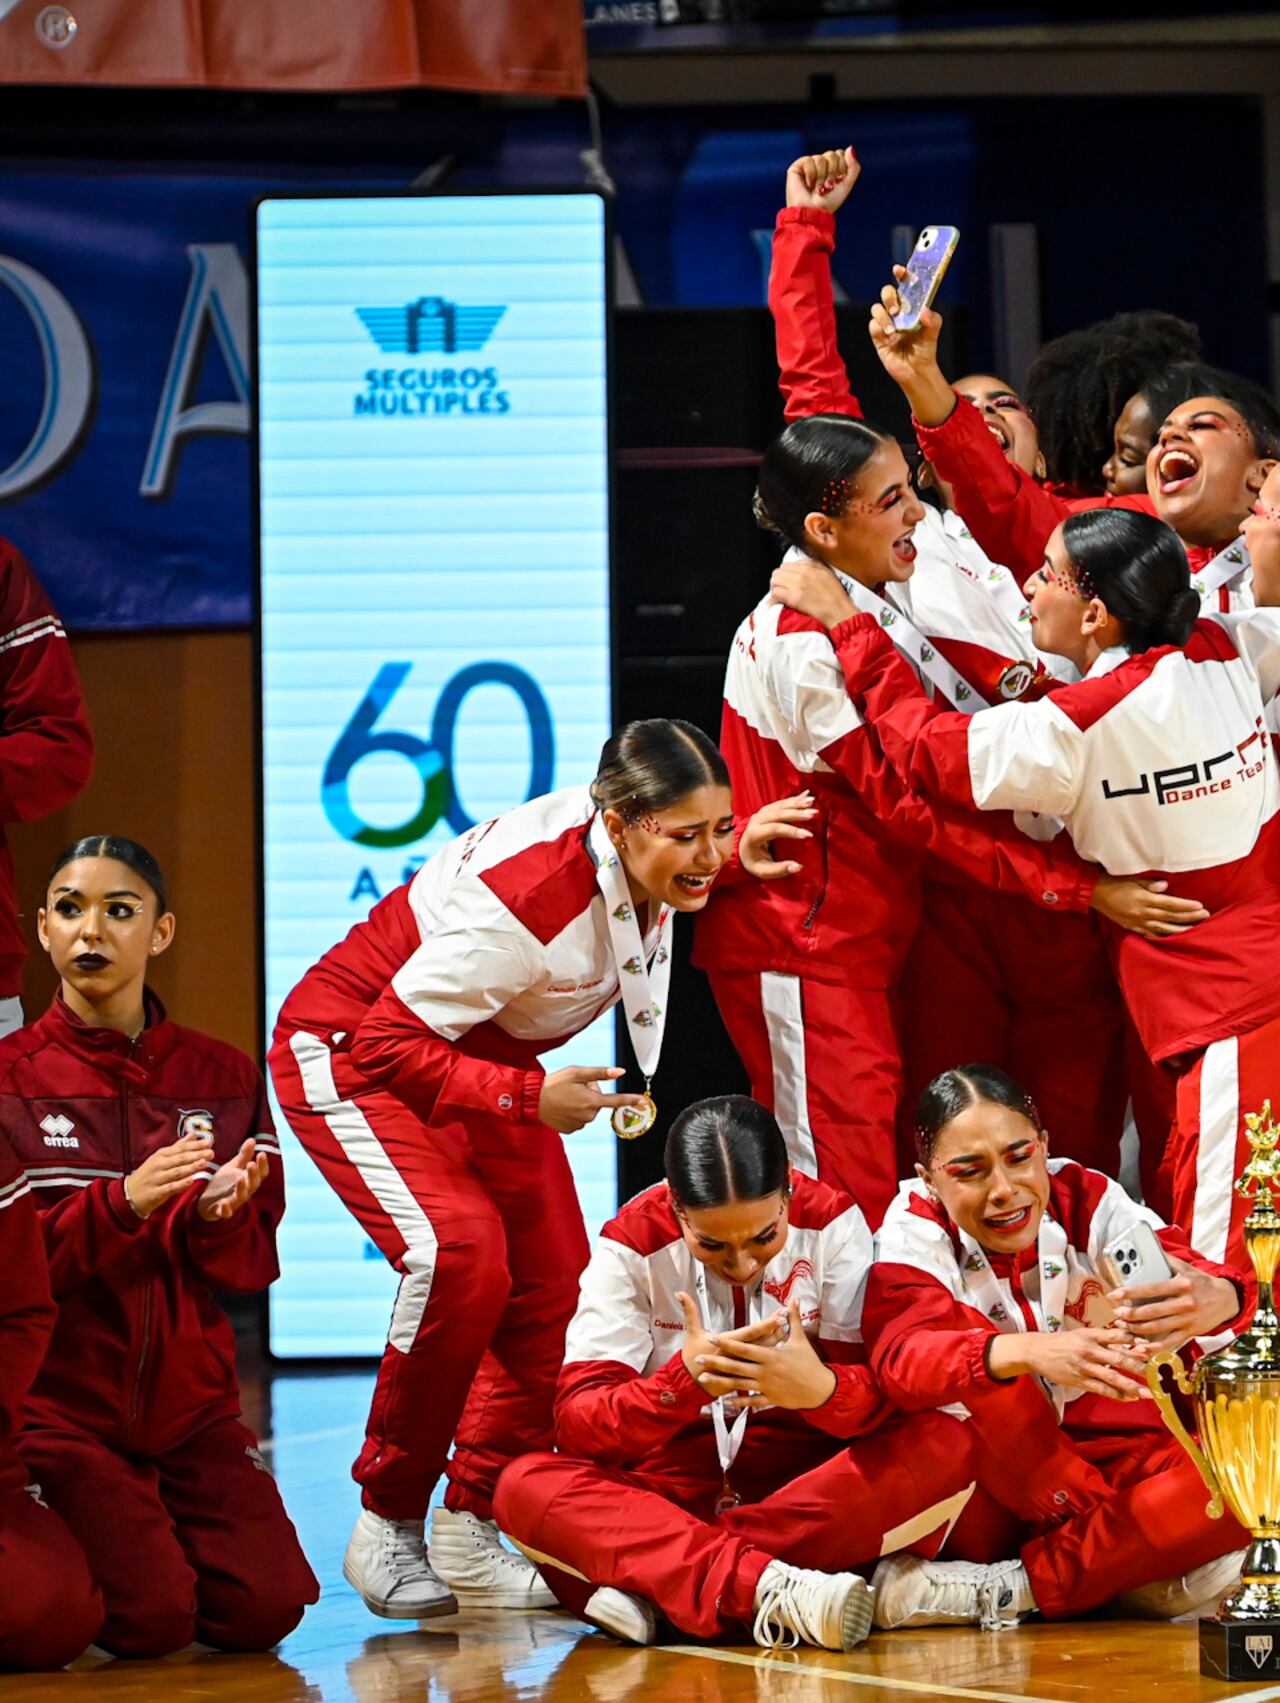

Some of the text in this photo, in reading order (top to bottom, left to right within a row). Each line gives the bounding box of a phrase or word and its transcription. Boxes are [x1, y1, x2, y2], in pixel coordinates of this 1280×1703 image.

[584, 3, 656, 25] ANES
[365, 366, 498, 391] SEGUROS
[353, 390, 511, 415] MULTIPLES
[321, 659, 556, 848] 60
[1165, 756, 1266, 804] Dance Tea
[43, 1136, 79, 1148] errea
